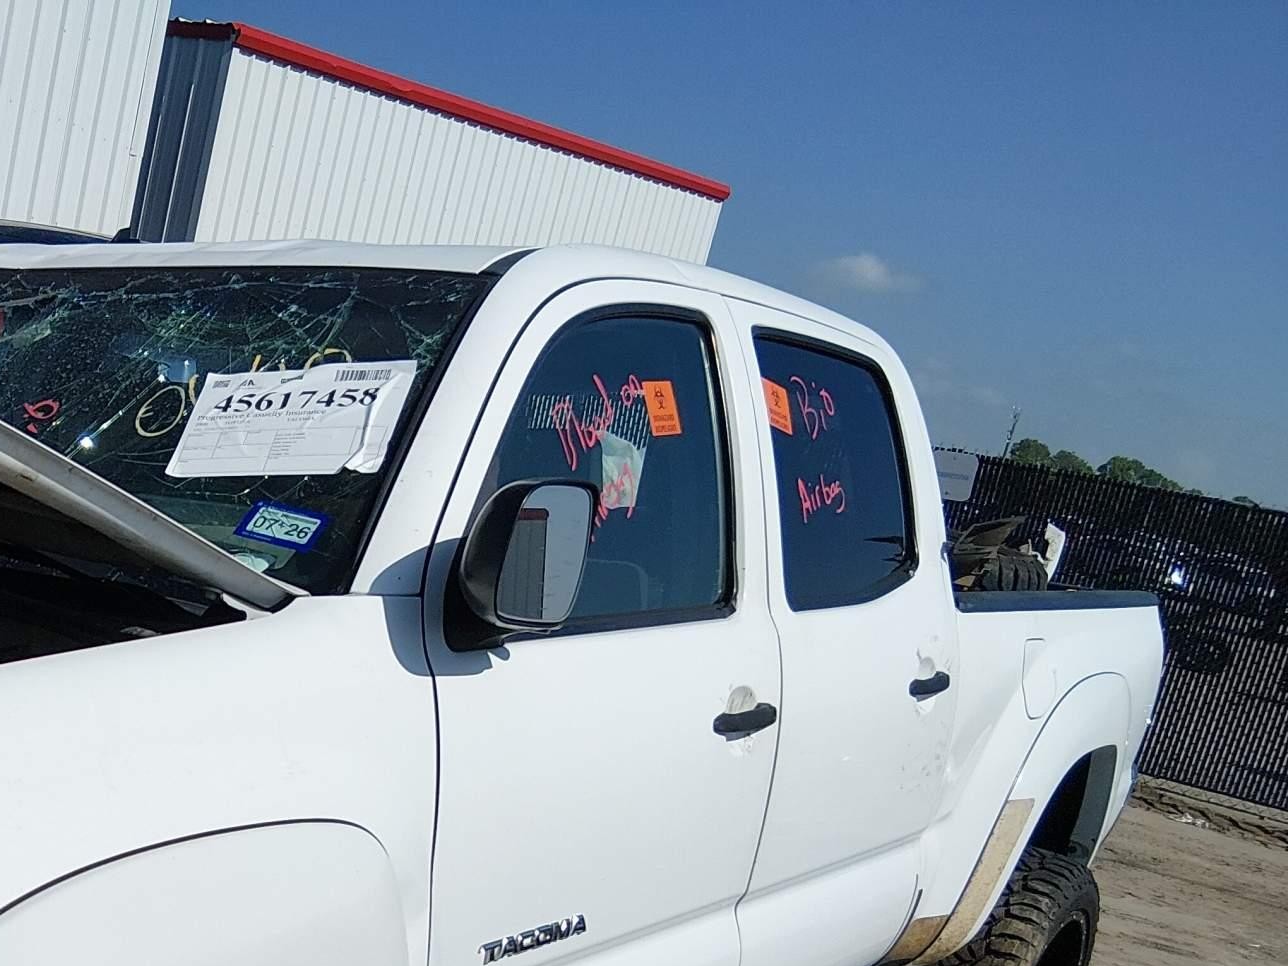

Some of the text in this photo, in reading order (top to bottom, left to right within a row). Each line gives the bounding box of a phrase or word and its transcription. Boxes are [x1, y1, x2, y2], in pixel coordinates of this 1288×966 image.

[214, 387, 380, 413] 45617458
[253, 515, 278, 530] 07
[284, 523, 311, 540] 26
[476, 912, 587, 965] TACOMA
